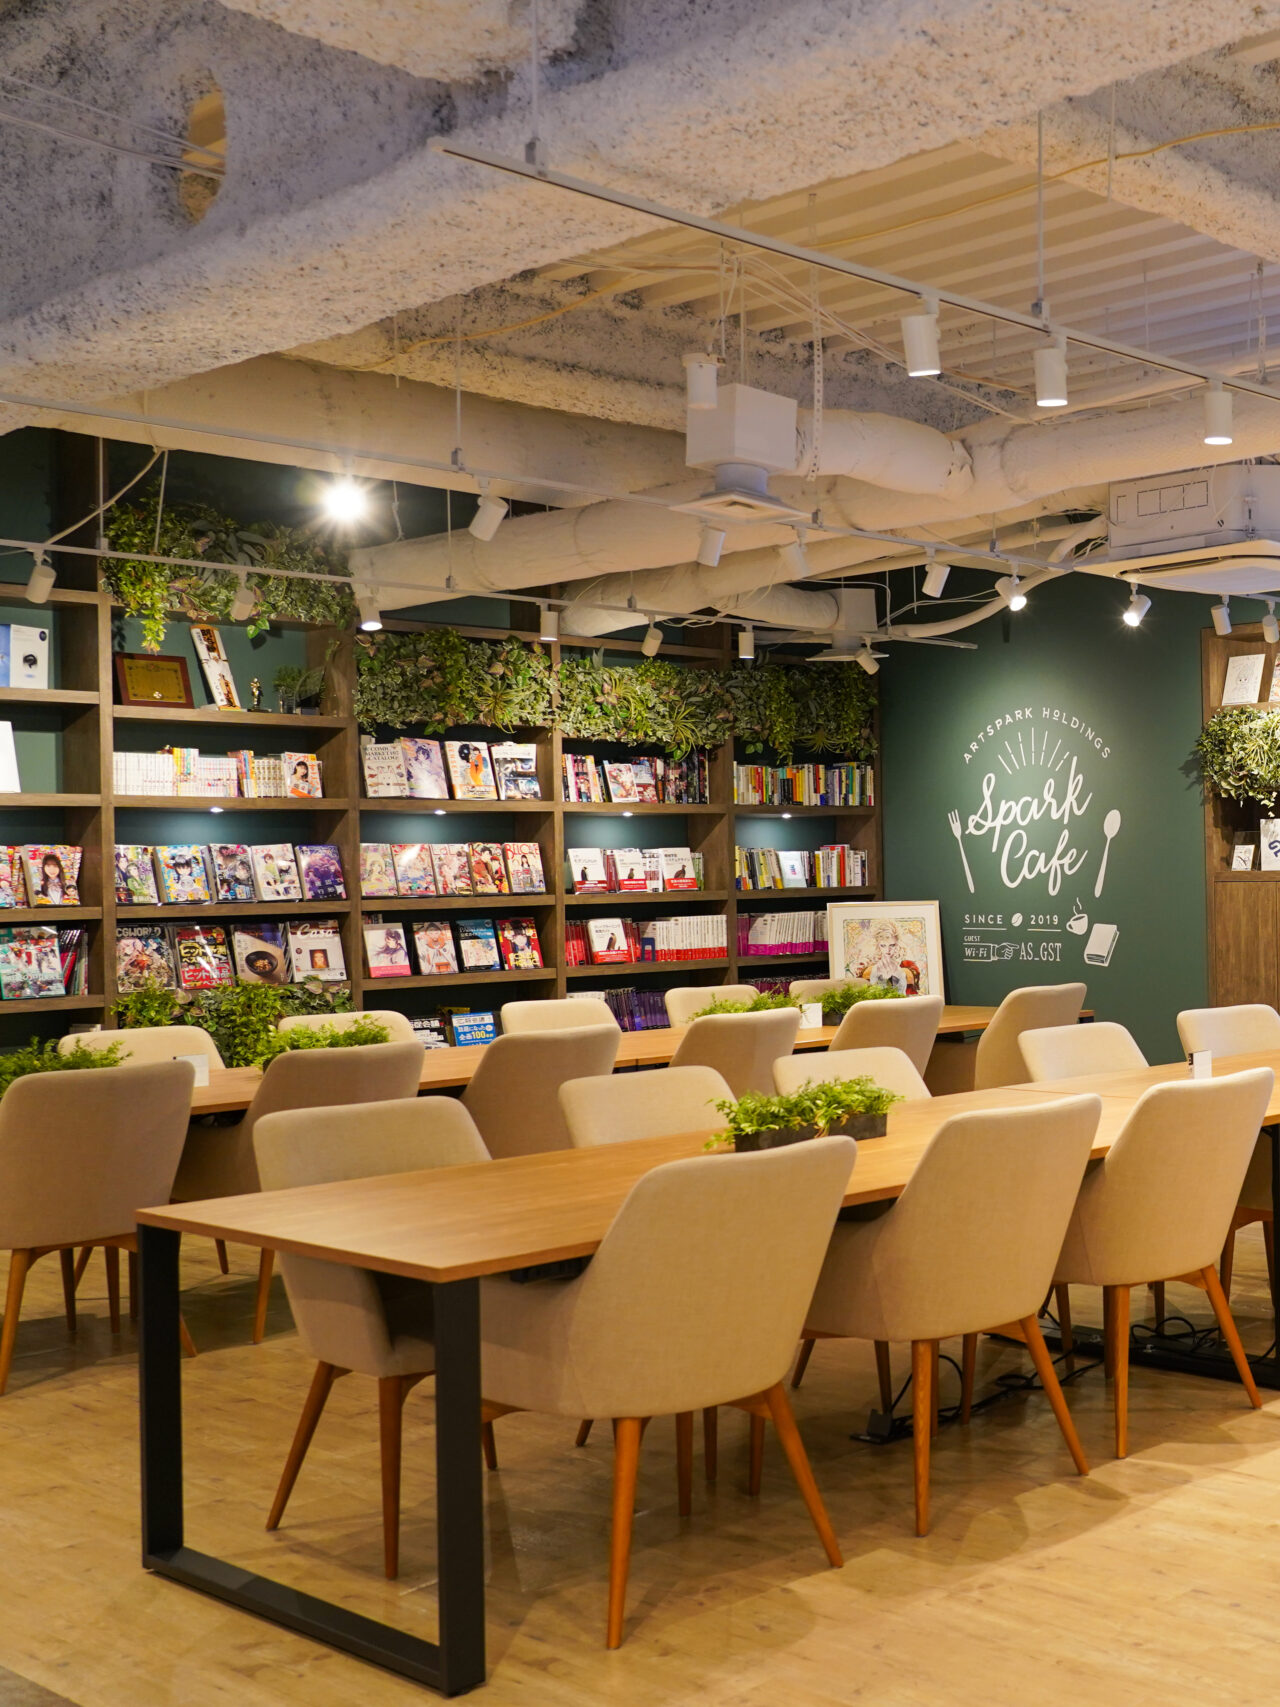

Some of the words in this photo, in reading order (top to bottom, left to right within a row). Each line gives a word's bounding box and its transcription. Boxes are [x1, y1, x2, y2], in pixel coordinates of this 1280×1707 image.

[962, 707, 1033, 763] ARTSPARK
[1042, 707, 1111, 759] HOLDINGS
[965, 755, 1092, 853] Spark
[1000, 829, 1088, 896] Cafe
[964, 914, 1003, 925] SINCE
[1030, 914, 1059, 925] 2019
[964, 947, 988, 957] Wi-Fi
[1019, 942, 1062, 962] AS_GST
